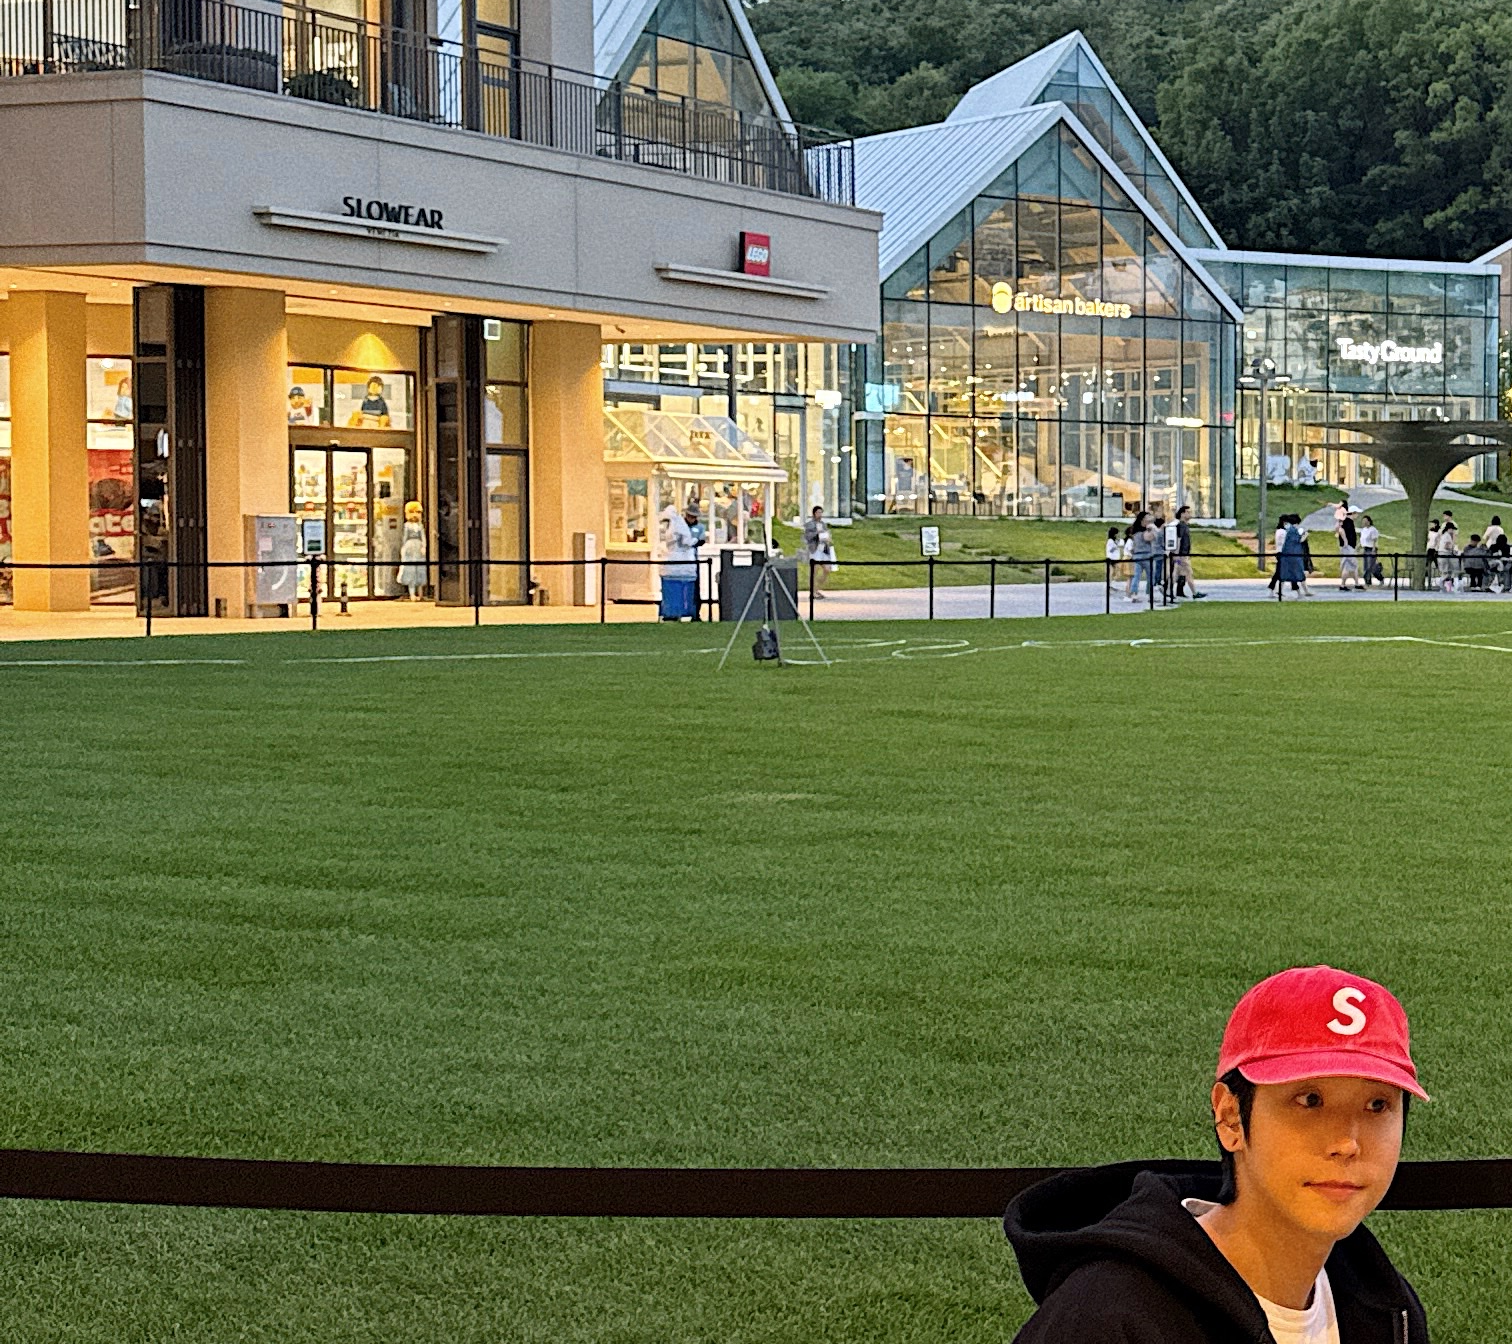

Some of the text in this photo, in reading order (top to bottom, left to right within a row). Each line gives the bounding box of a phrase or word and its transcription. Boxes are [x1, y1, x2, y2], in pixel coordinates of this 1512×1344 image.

[341, 196, 444, 230] SLOWEAR
[745, 246, 769, 264] LEGO
[1074, 296, 1132, 319] bakers
[1335, 337, 1443, 365] Tasty Ground
[1326, 986, 1367, 1036] S
